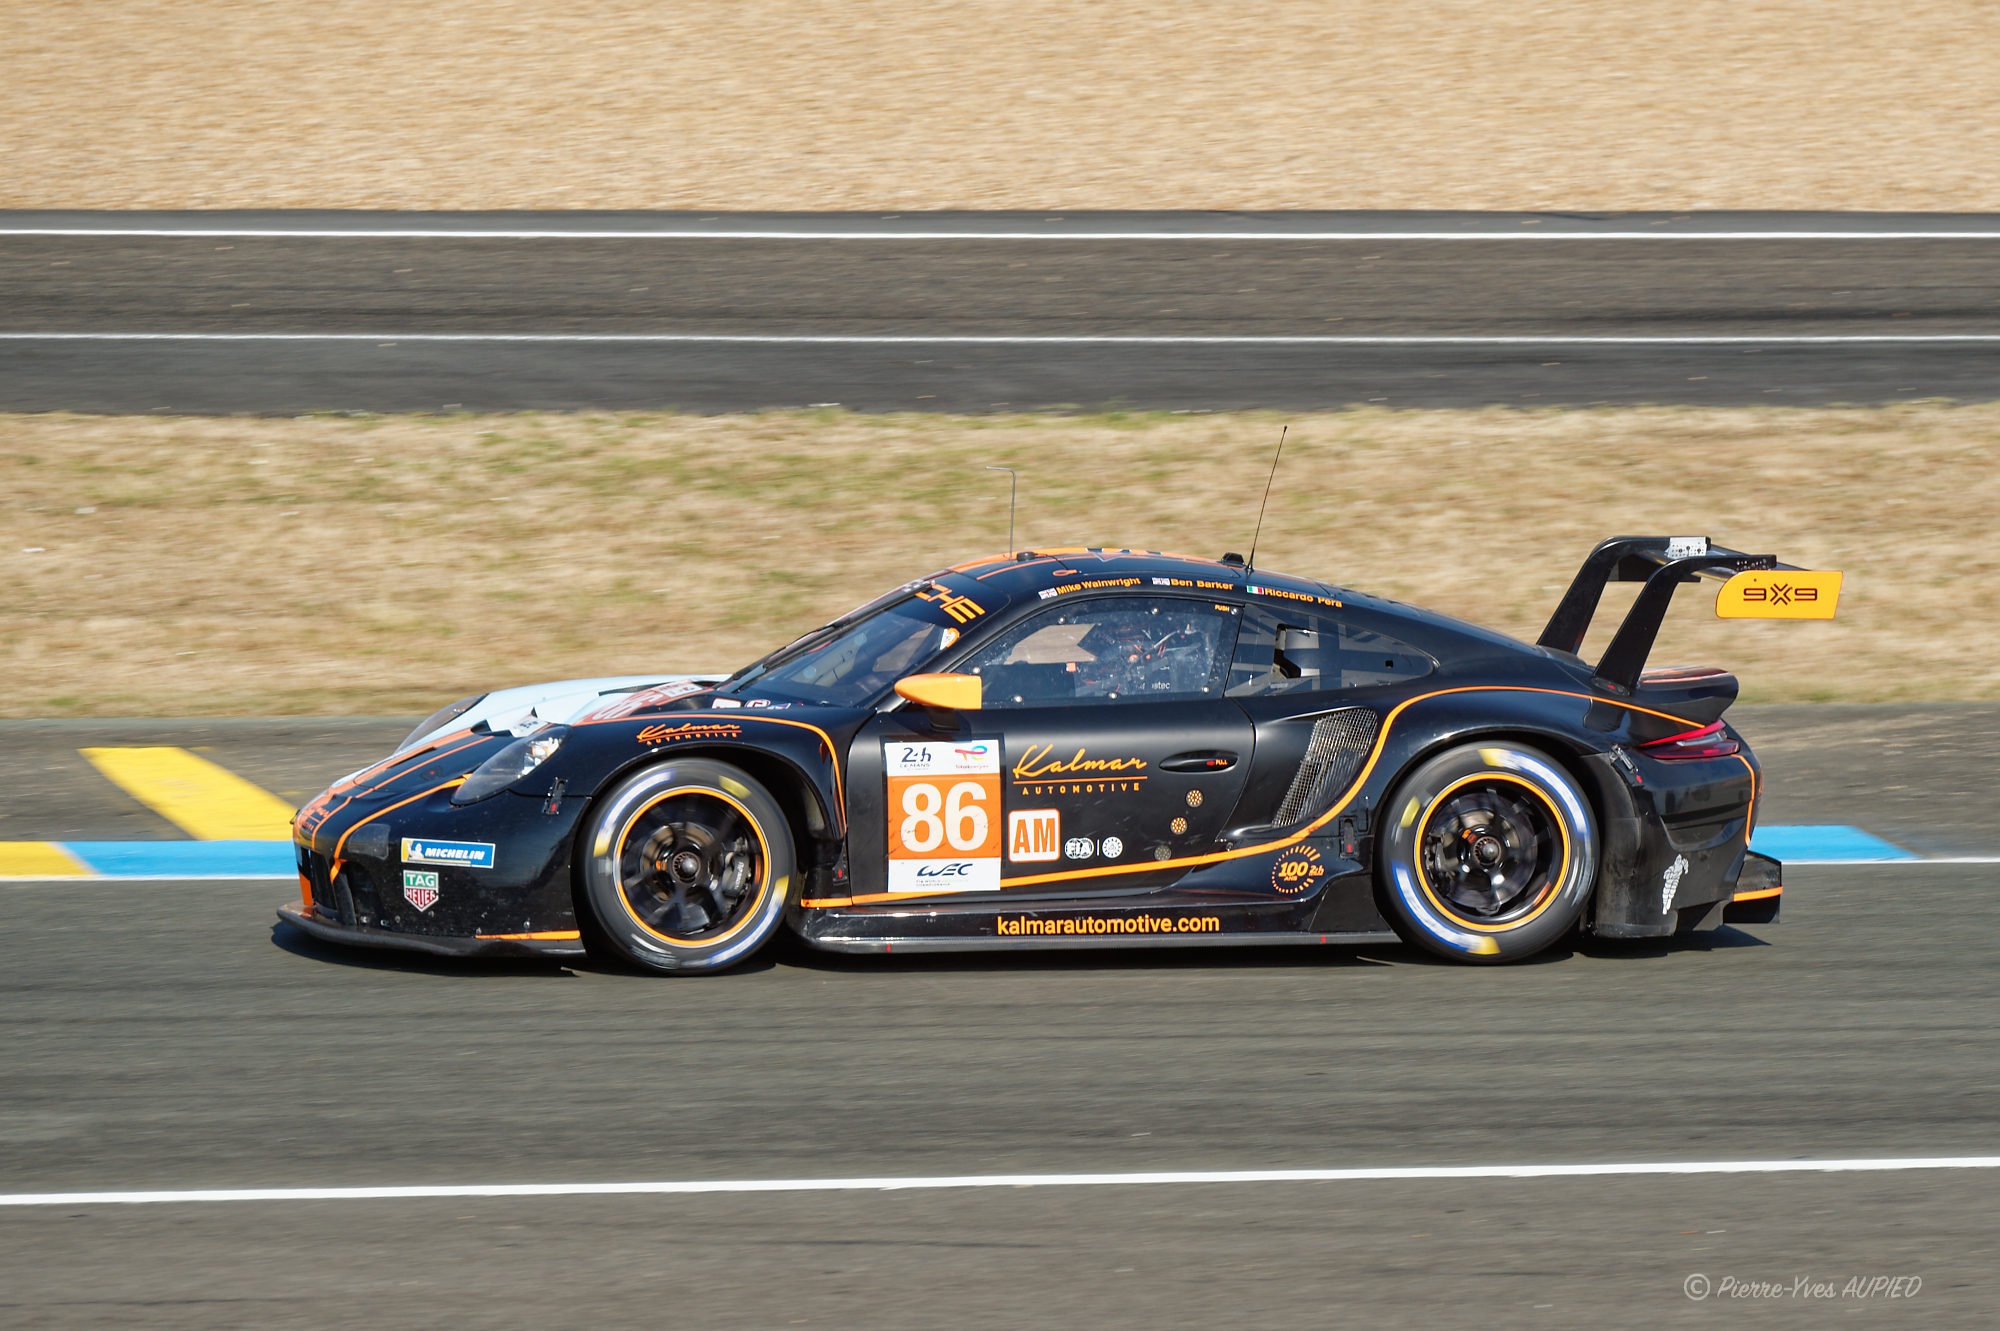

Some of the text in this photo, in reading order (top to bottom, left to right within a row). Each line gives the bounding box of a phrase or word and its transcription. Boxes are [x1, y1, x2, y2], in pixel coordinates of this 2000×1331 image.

[1056, 577, 1141, 595] Mike Wainwright
[1171, 578, 1234, 590] Ben Barker
[1265, 588, 1342, 608] Riccardo Pera
[1214, 604, 1230, 612] PUSH
[637, 722, 741, 740] Kalmar
[647, 732, 737, 745] AUTOMOTIVE
[1013, 744, 1148, 778] Kalmar
[1022, 783, 1140, 795] AUTOMOTIVE
[901, 781, 988, 852] 86
[1013, 818, 1056, 854] AM
[425, 847, 485, 860] MICHELIN
[916, 863, 973, 877] WEC
[1278, 861, 1309, 877] 100
[407, 874, 435, 887] TAG
[406, 888, 436, 907] HEUER
[997, 914, 1220, 935] kalmarautomotive.com
